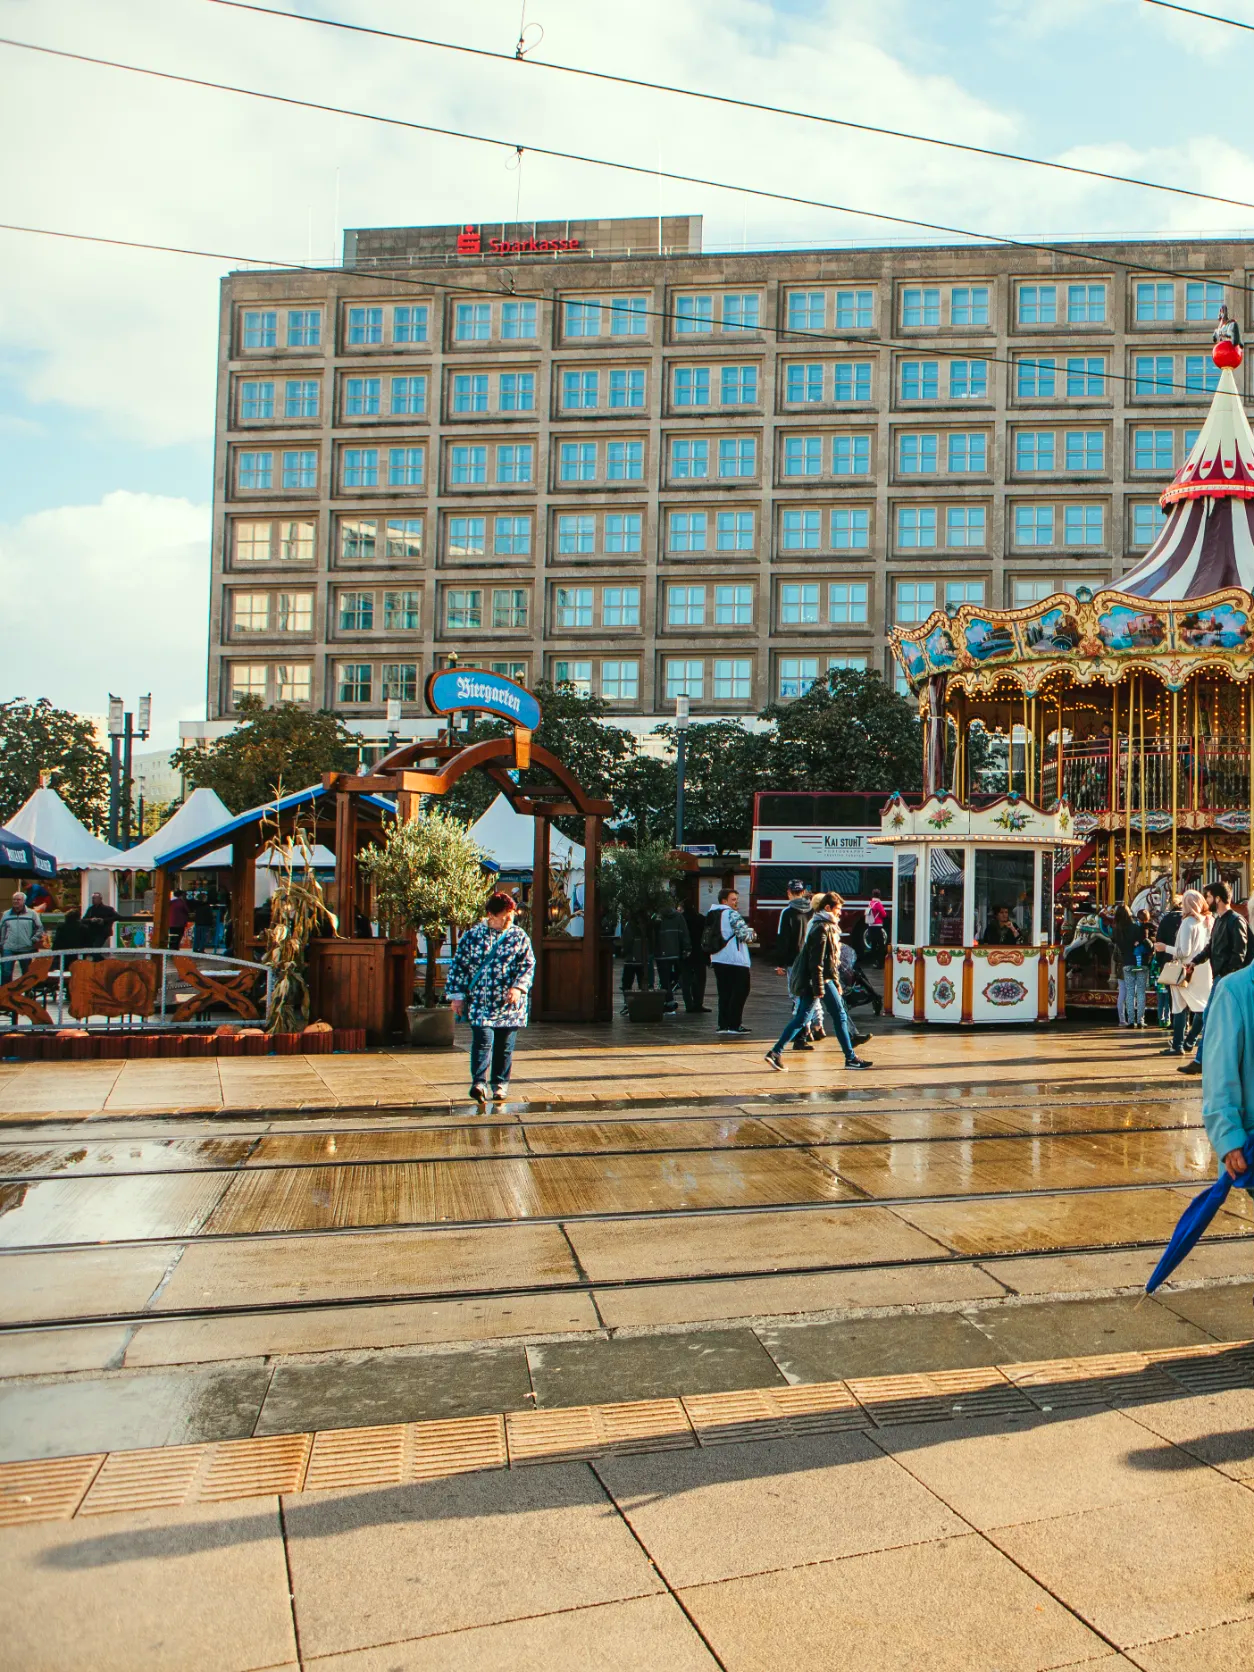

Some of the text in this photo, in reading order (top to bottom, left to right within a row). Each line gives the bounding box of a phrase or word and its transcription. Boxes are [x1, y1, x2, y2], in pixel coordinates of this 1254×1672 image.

[489, 236, 579, 256] Sparkasse
[456, 676, 520, 712] Biergarten
[824, 835, 864, 847] KAI STUHT
